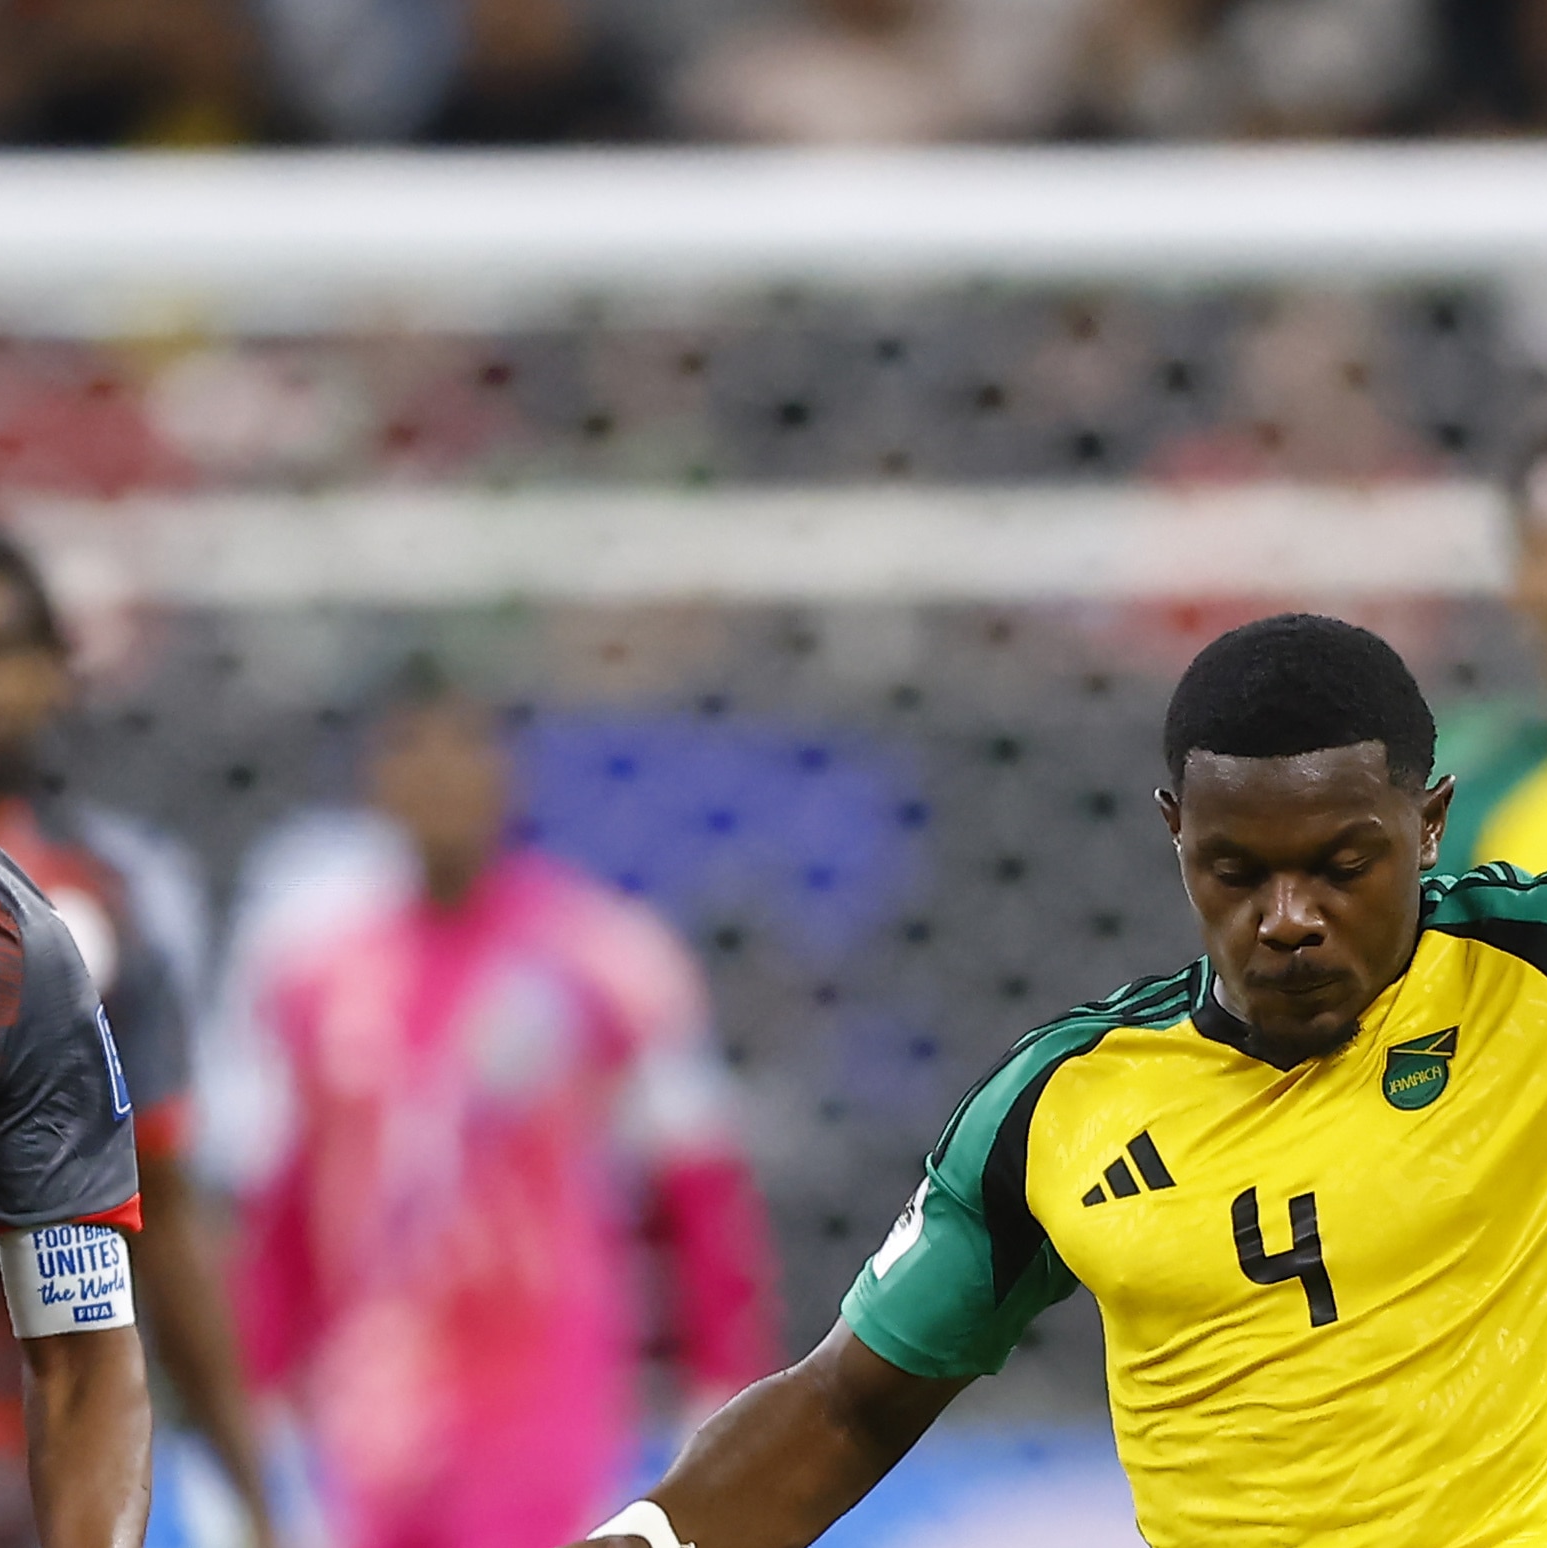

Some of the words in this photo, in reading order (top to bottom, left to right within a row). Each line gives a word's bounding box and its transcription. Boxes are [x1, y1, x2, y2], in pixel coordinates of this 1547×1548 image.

[1388, 1064, 1443, 1096] JAMAICA
[37, 1238, 120, 1279] UNITES
[1230, 1186, 1339, 1328] 4
[37, 1280, 76, 1306] the
[78, 1268, 126, 1301] World
[76, 1306, 112, 1320] FIFA
